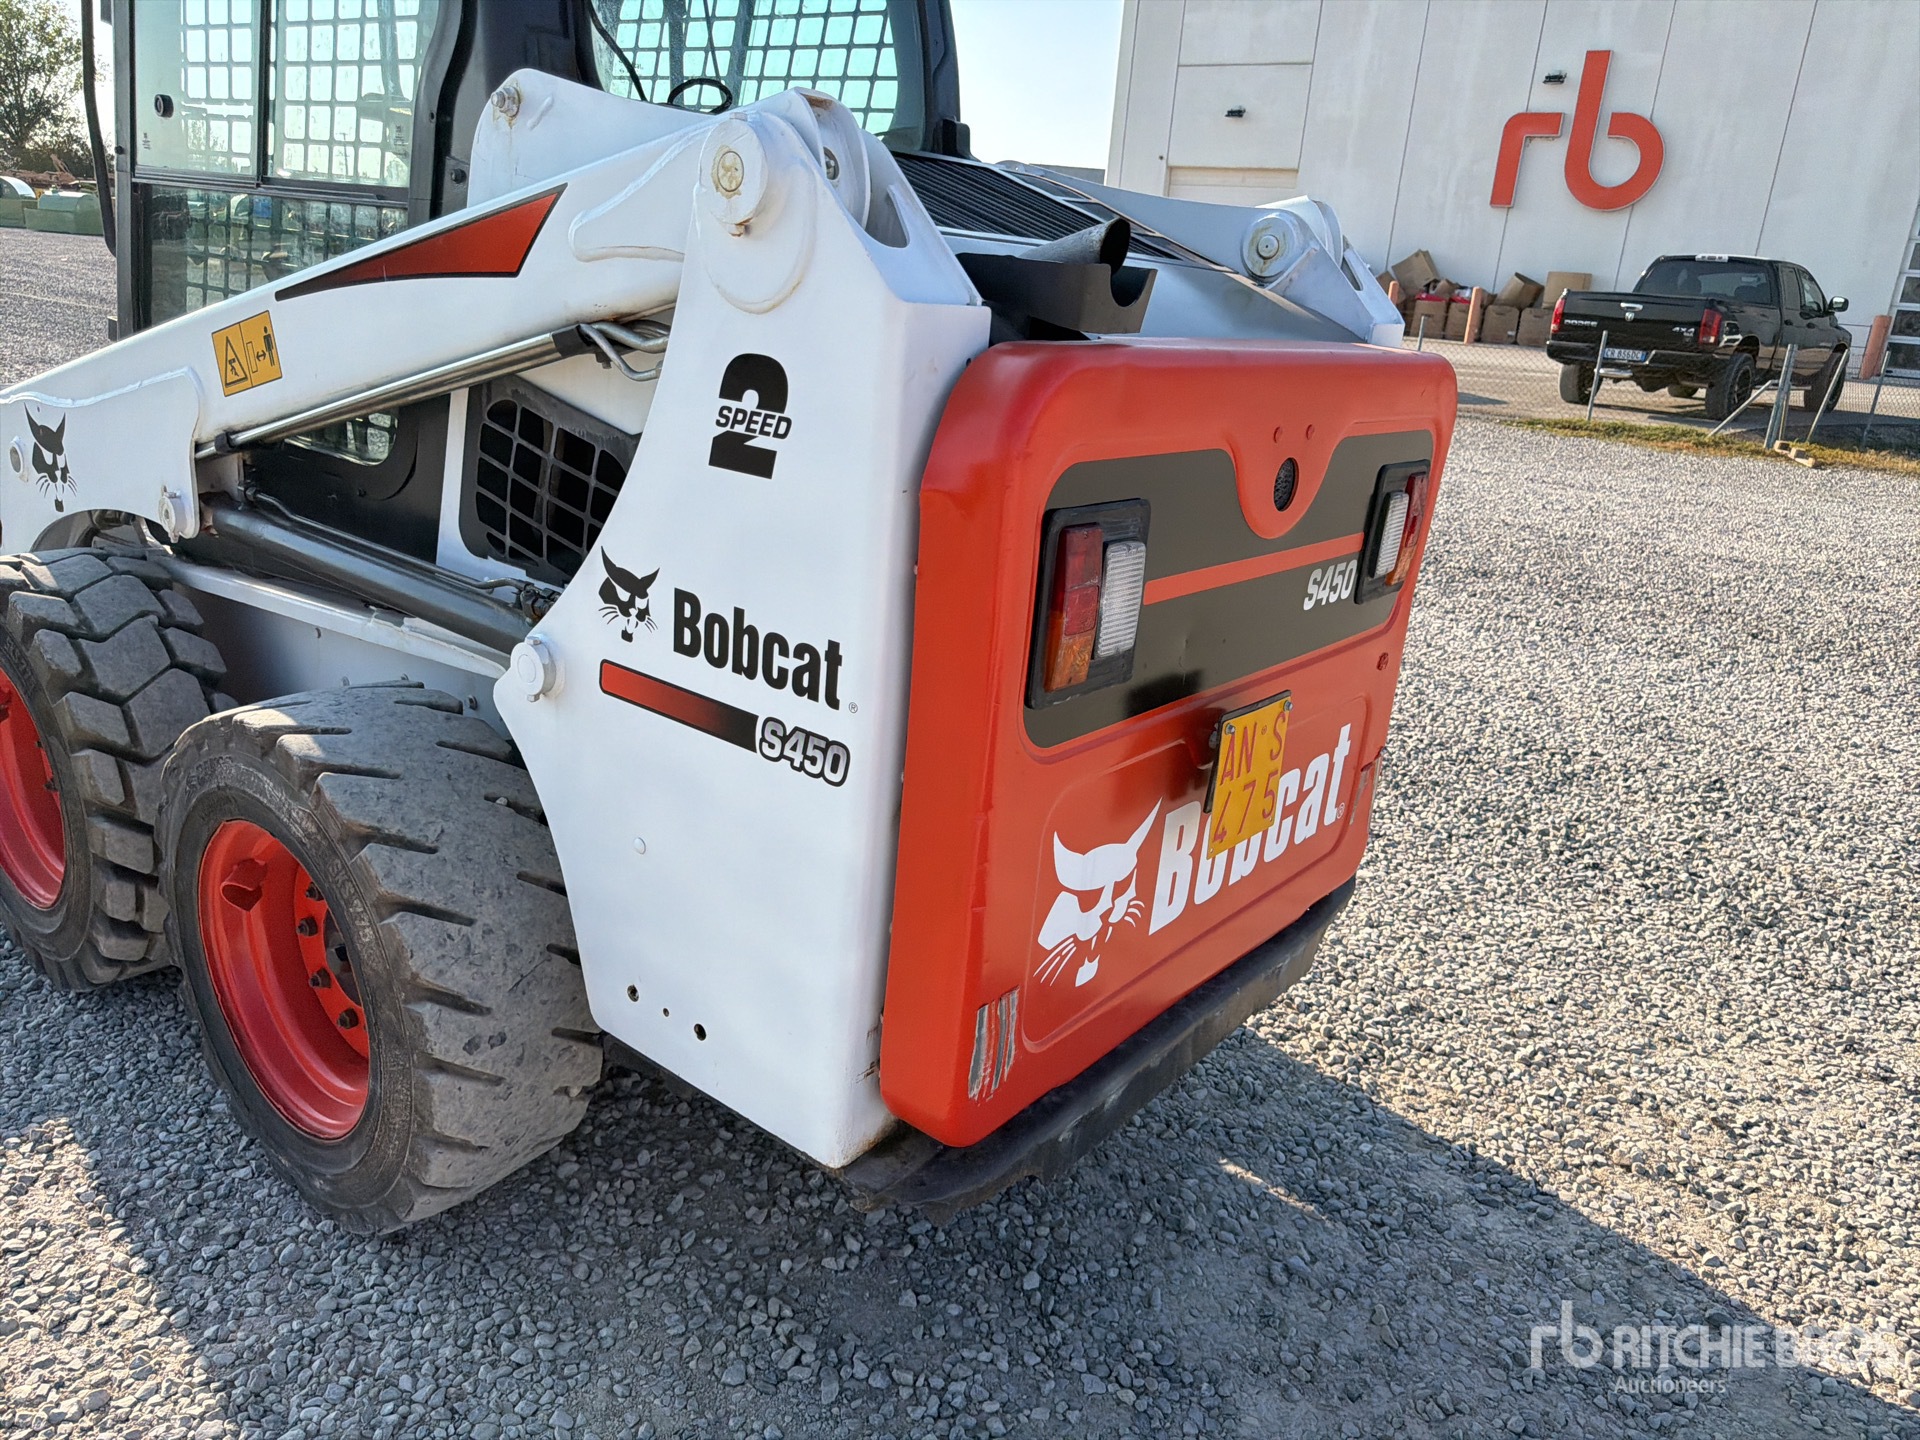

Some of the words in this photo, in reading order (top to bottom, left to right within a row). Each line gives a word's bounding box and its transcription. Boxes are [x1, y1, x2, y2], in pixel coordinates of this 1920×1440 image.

[1490, 50, 1665, 212] rb
[709, 353, 788, 479] 2
[716, 405, 793, 440] SPEED
[1303, 559, 1358, 610] S450
[674, 587, 843, 711] Bobcat
[760, 716, 850, 788] S450
[1219, 721, 1258, 786] AN
[1270, 710, 1287, 762] S
[1212, 771, 1279, 843] 475
